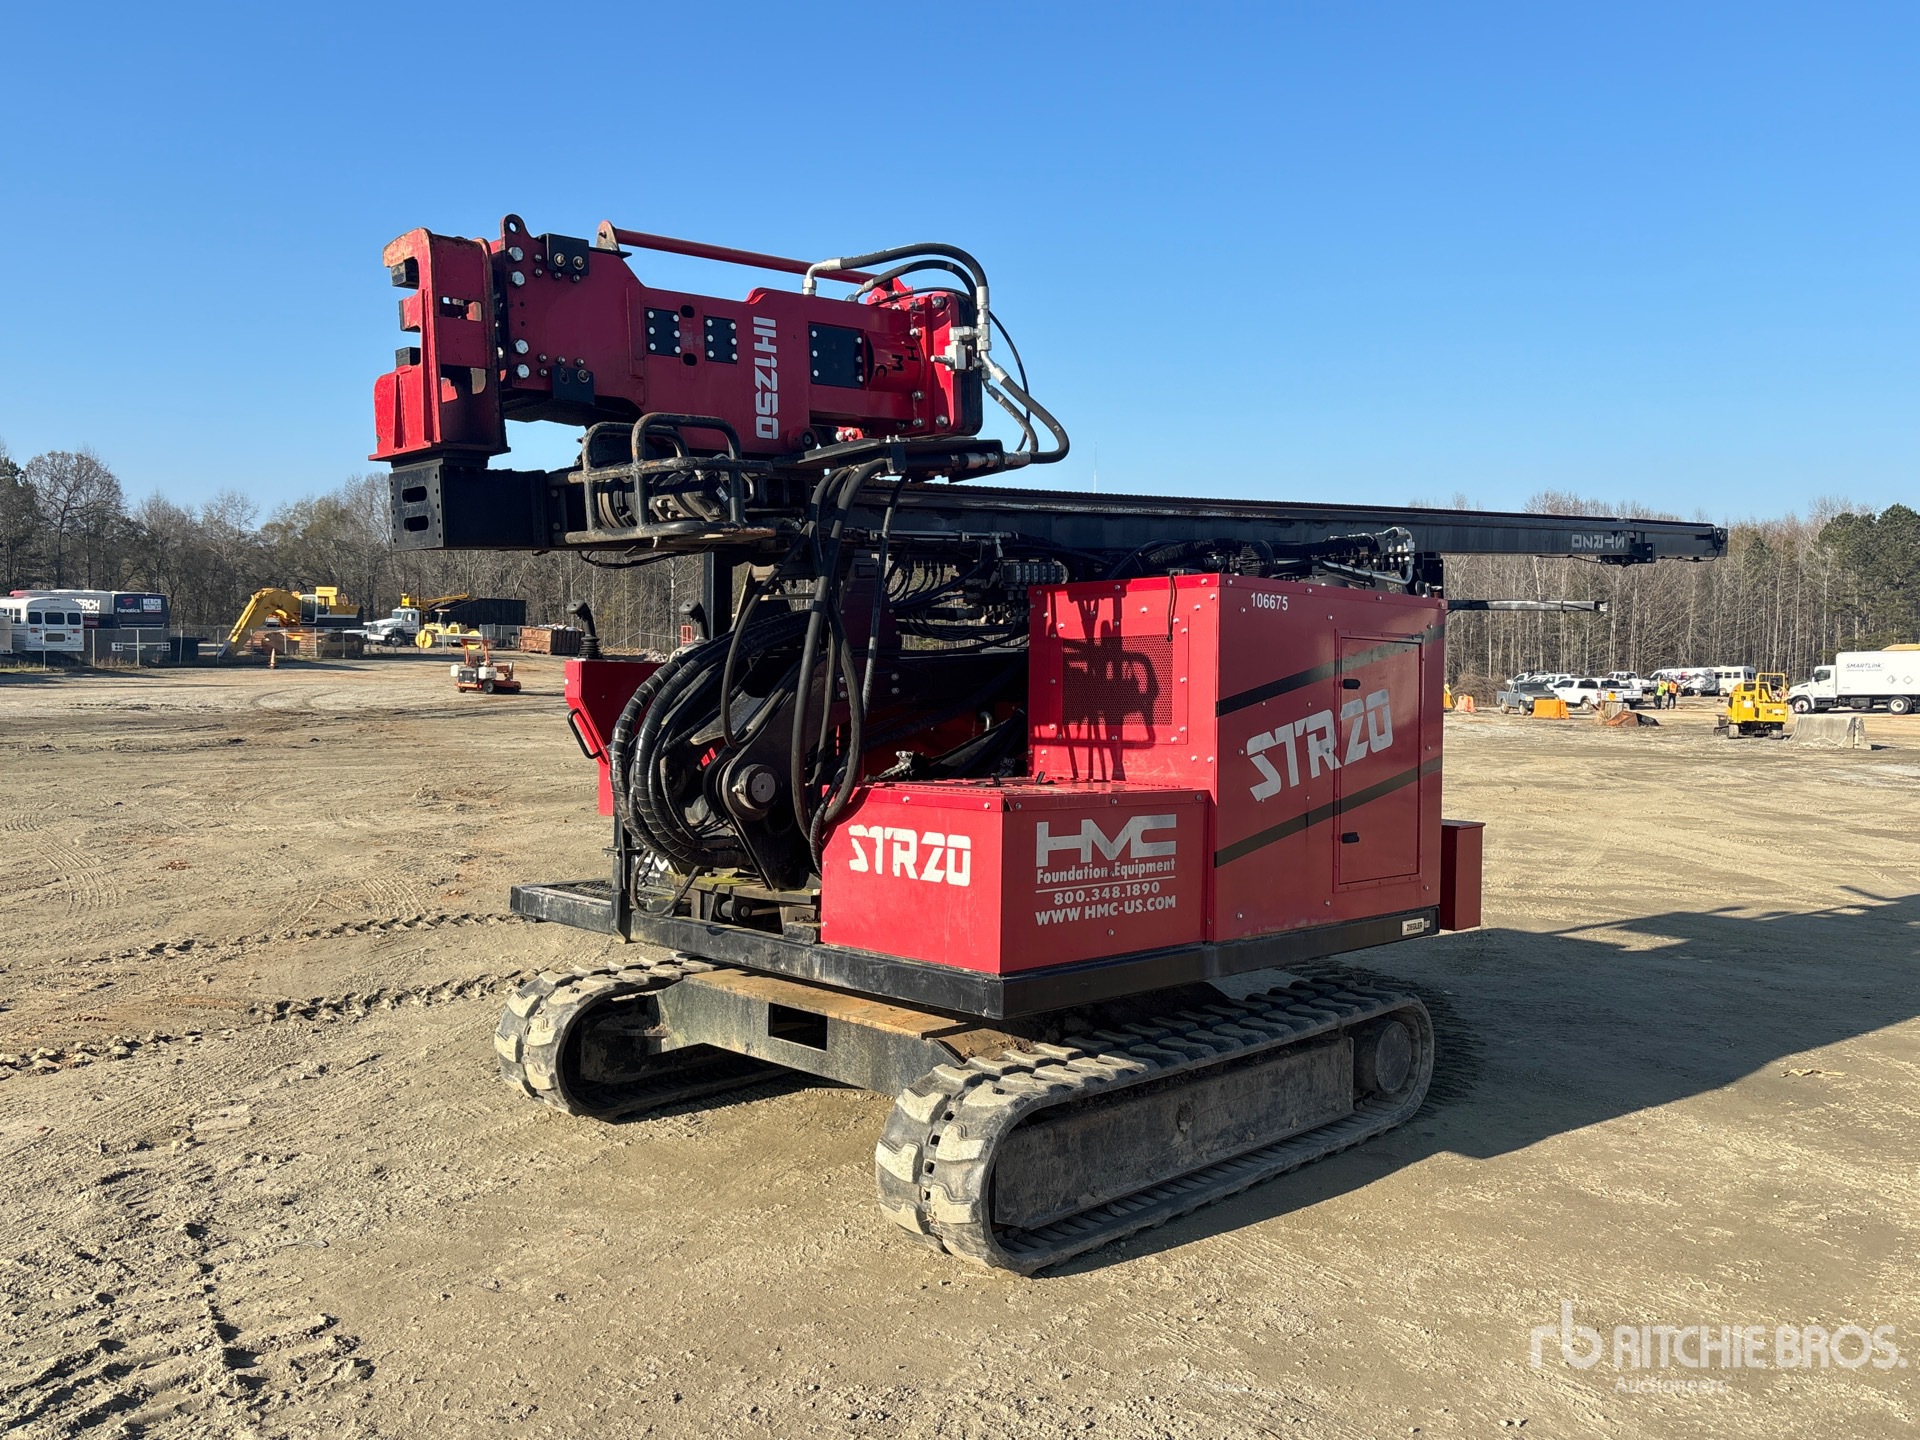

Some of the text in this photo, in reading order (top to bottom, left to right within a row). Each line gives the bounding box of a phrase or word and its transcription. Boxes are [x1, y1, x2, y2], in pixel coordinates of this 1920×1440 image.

[1250, 592, 1289, 611] 106675
[1036, 813, 1177, 868] HMC
[1036, 858, 1176, 884] Foundation Equipment
[1053, 881, 1161, 906] 800.348.1890
